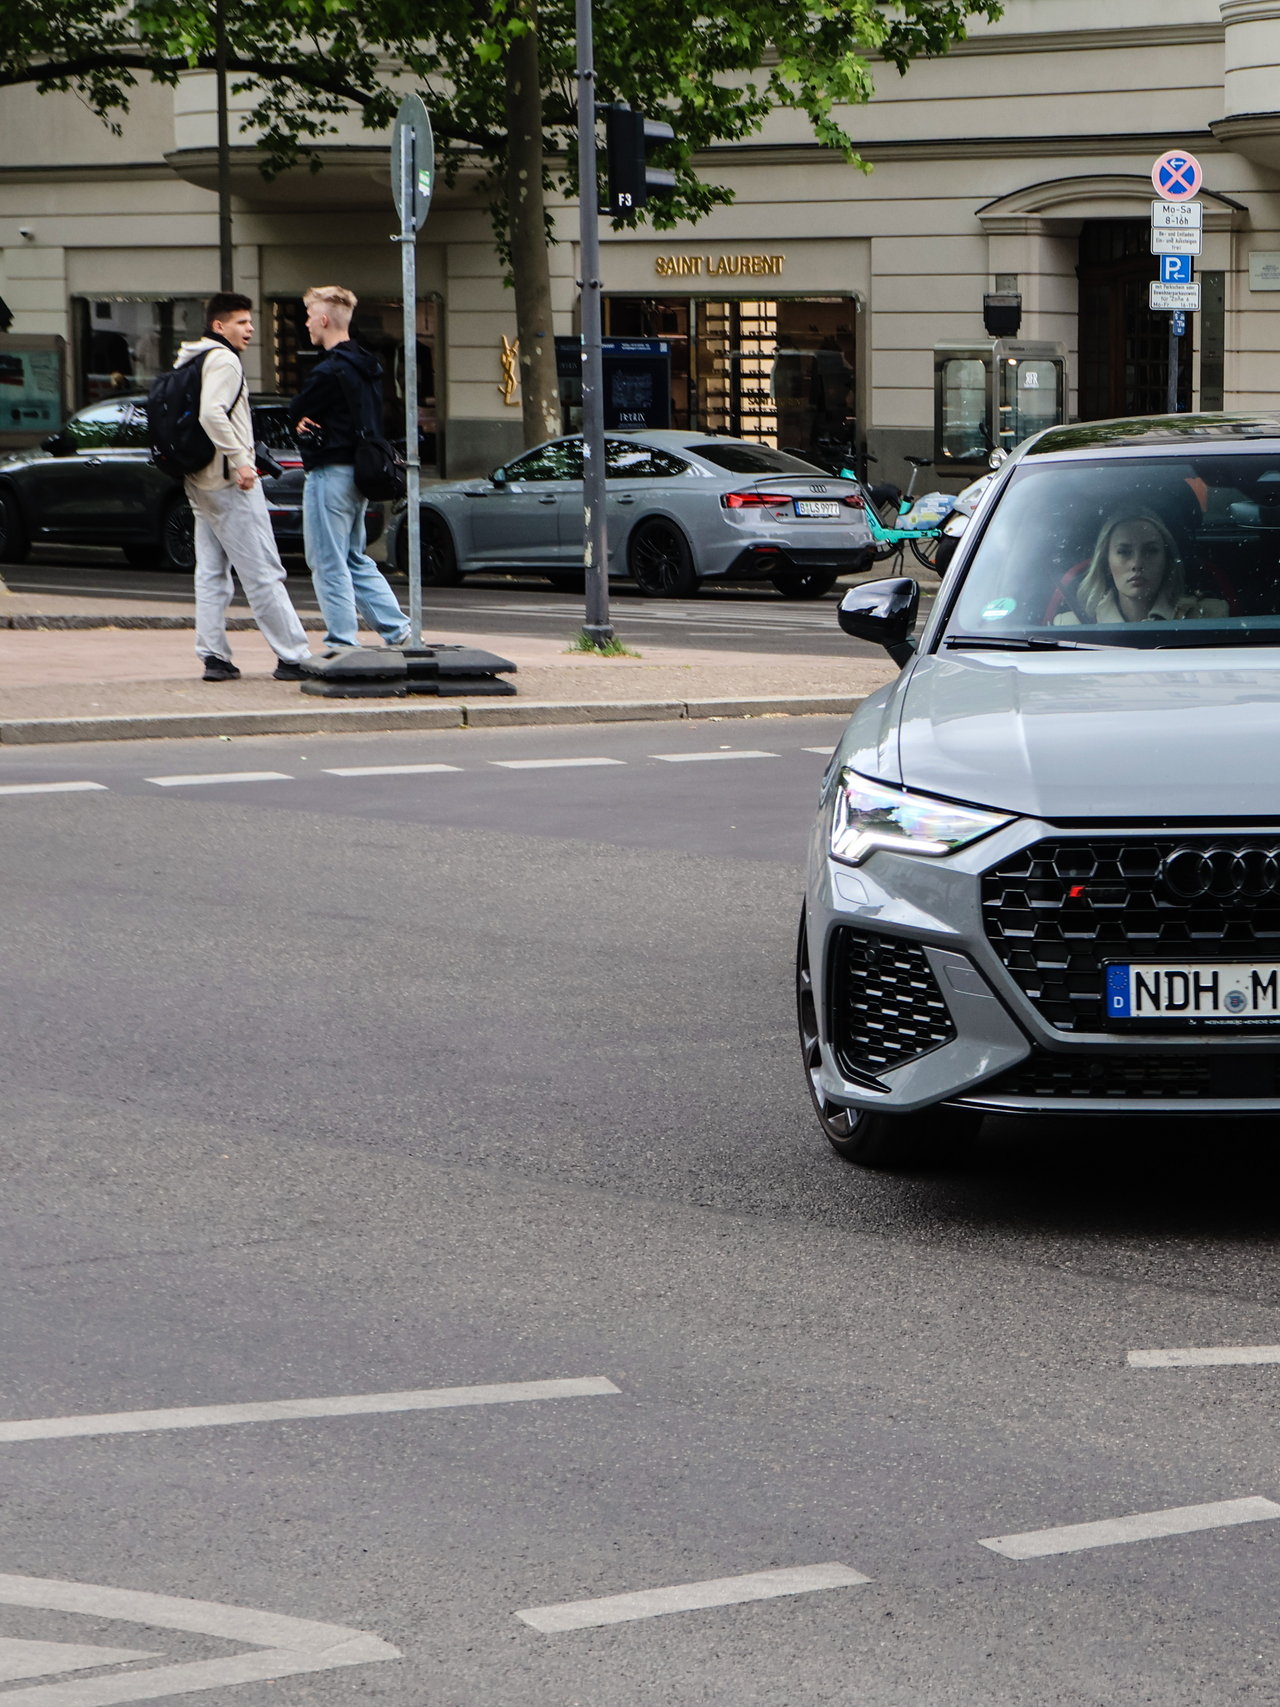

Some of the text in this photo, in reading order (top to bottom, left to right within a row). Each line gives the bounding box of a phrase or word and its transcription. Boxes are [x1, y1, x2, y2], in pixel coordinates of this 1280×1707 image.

[618, 193, 632, 207] F3
[1162, 205, 1192, 214] Mo-Sa
[1165, 216, 1189, 225] 8-16h
[655, 255, 785, 275] SAINT LAURENT
[1165, 257, 1181, 280] P
[800, 502, 806, 513] B
[809, 502, 820, 513] LS
[1113, 997, 1124, 1008] D
[1135, 970, 1219, 1011] NDH
